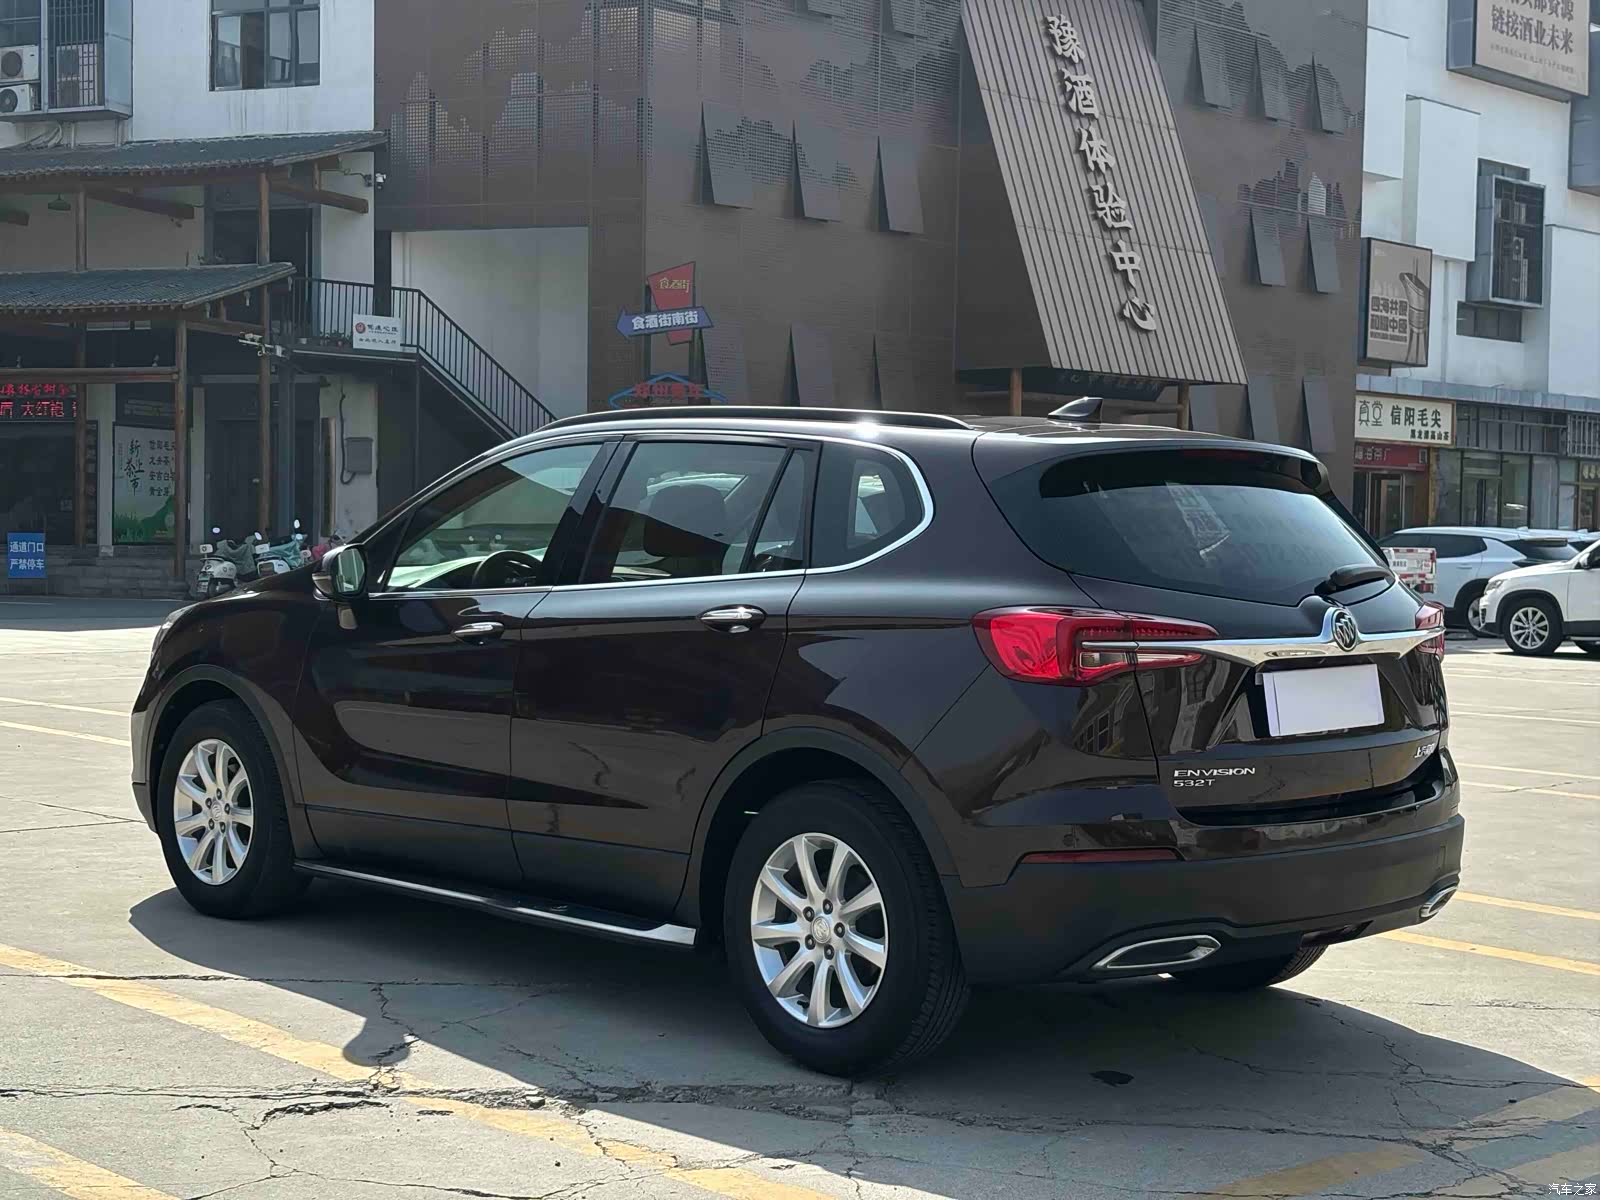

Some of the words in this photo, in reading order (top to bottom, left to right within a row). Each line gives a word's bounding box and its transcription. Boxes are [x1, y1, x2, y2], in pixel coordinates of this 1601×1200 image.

[1491, 4, 1574, 55] 链接酒业未来
[1047, 14, 1156, 332] 豫酒体验中心
[632, 311, 699, 330] 食酒街南街
[1390, 404, 1442, 428] 信阳毛尖
[10, 541, 44, 553] 通道门口
[10, 558, 45, 570] 严禁停车
[1174, 767, 1256, 778] ENVISION
[1173, 779, 1216, 788] 532T
